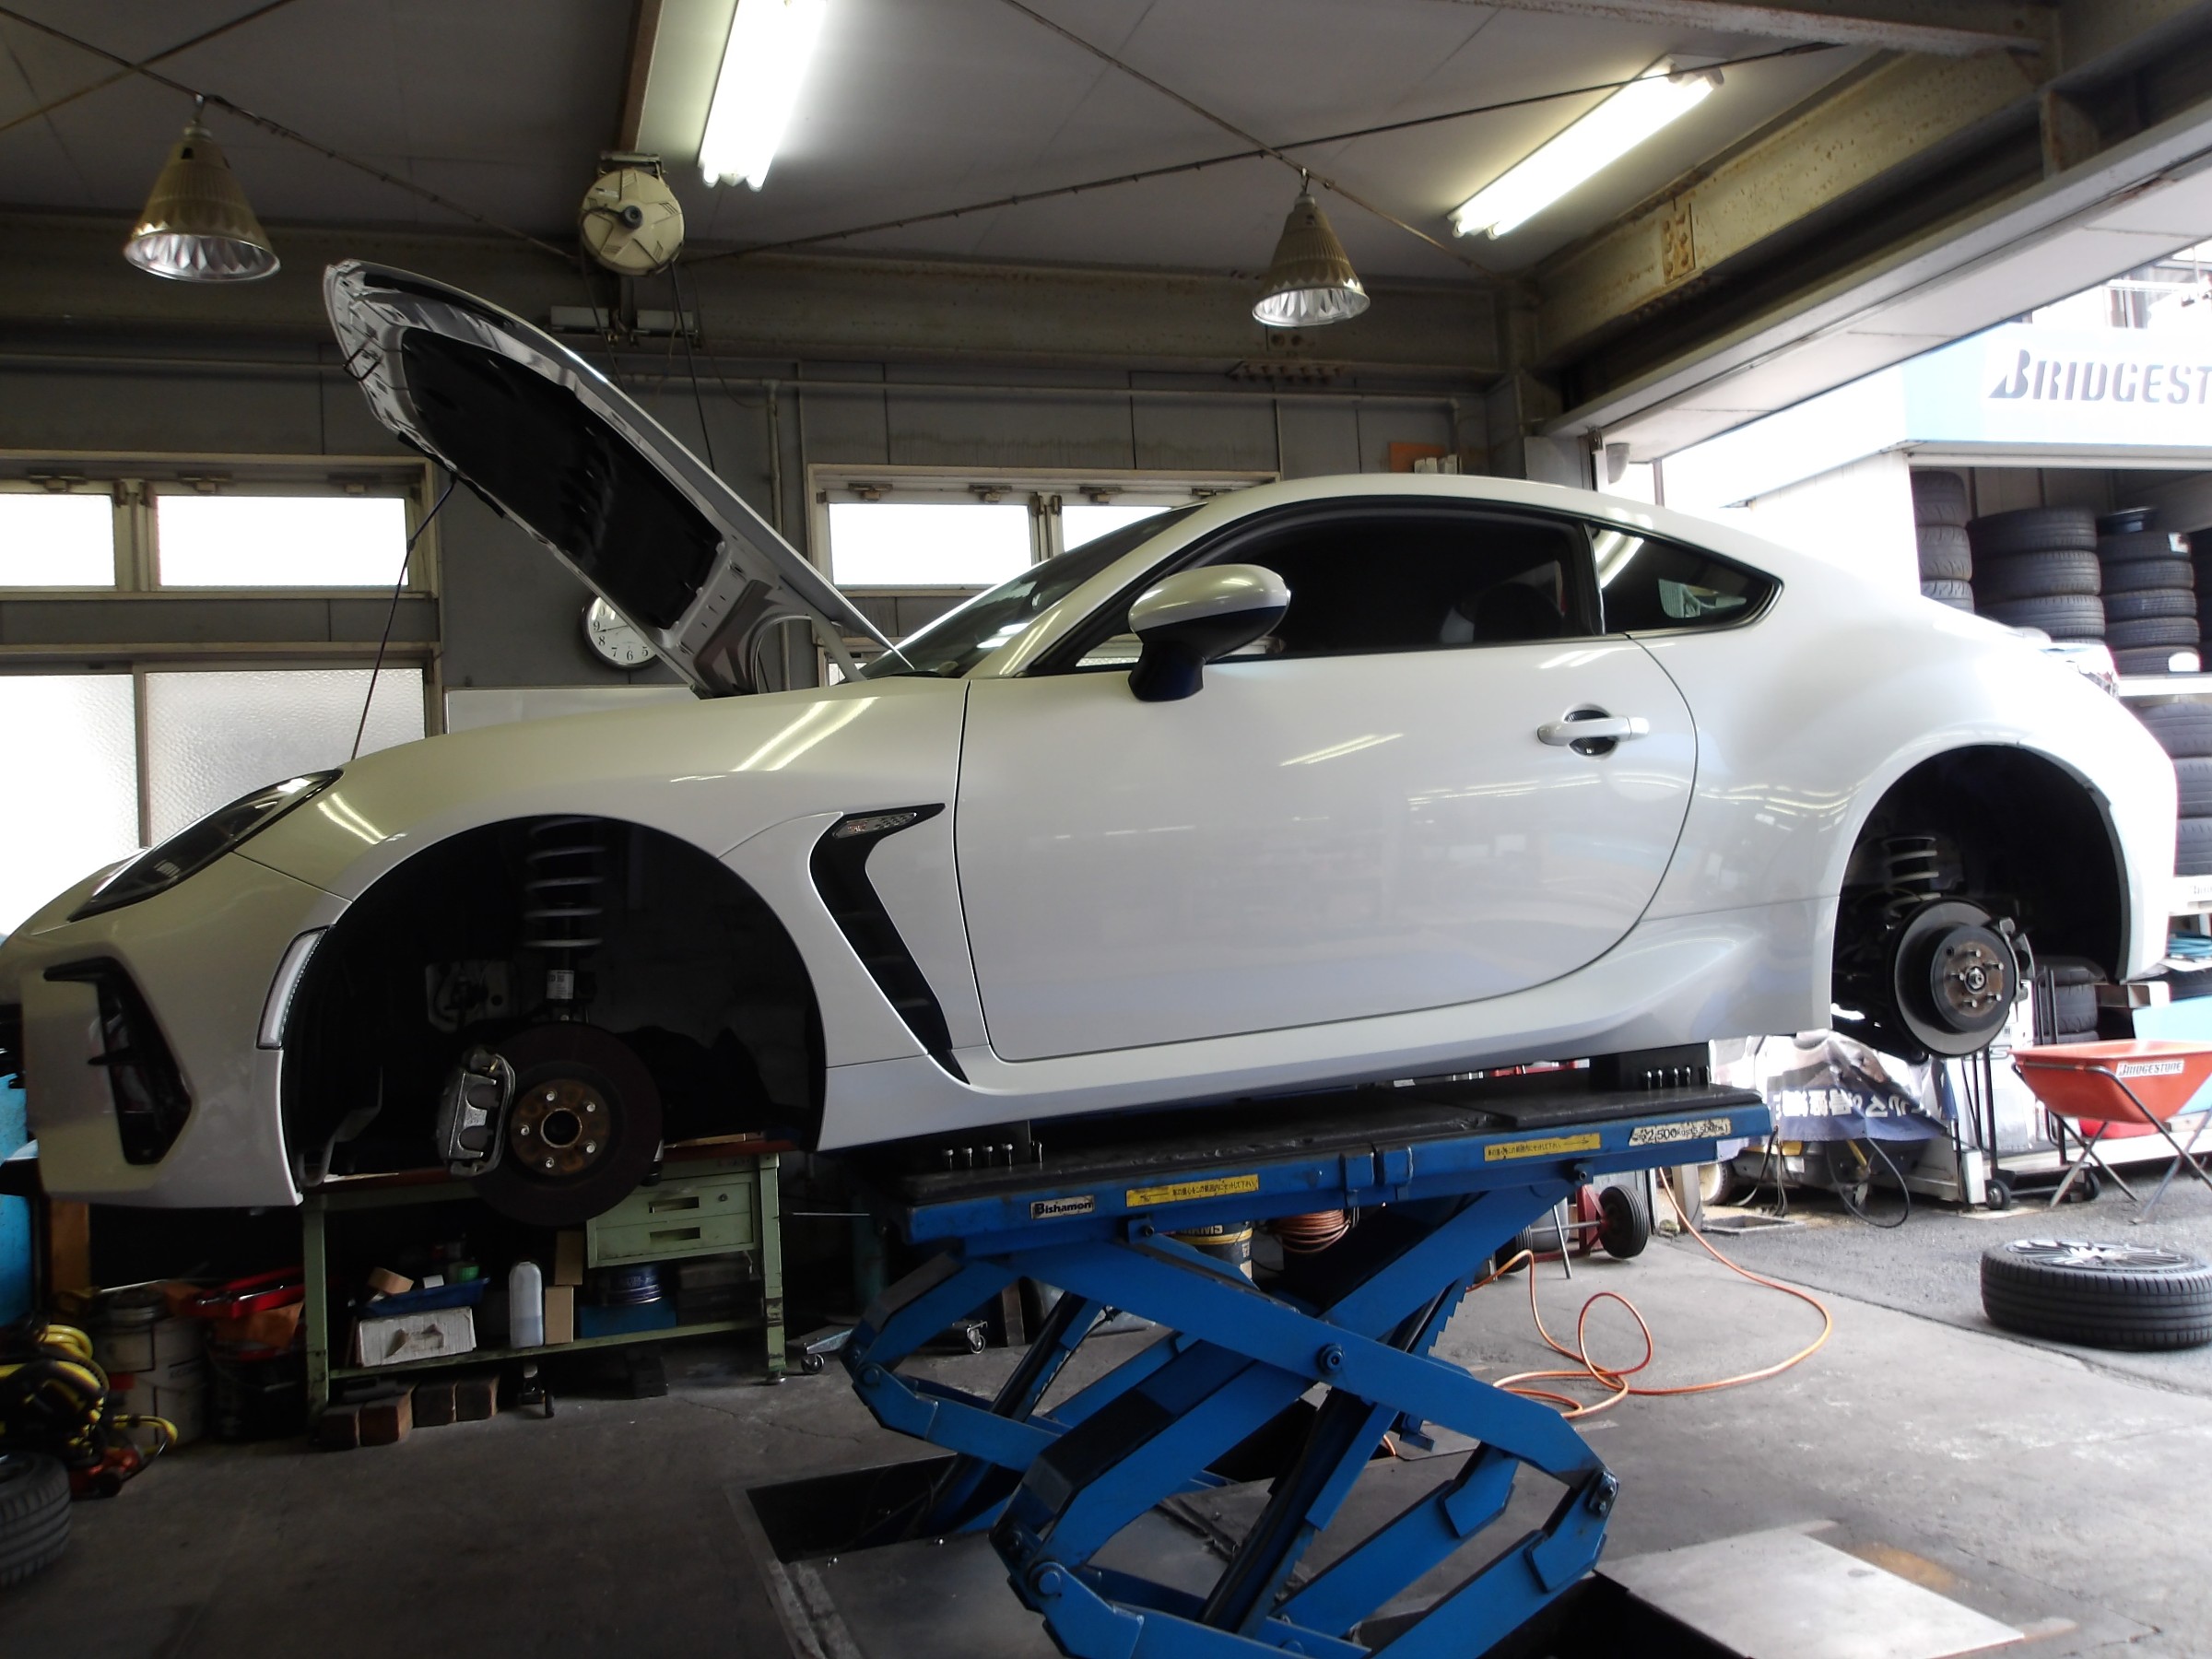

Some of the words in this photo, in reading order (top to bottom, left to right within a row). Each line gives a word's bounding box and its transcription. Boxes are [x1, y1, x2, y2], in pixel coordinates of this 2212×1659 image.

[593, 620, 601, 631] 9
[598, 635, 606, 646] 8
[611, 646, 618, 657] 7
[626, 650, 634, 662] 6
[641, 646, 649, 657] 5
[2118, 1062, 2183, 1077] BRIDGESTONE
[1033, 1201, 1092, 1216] Bishamon
